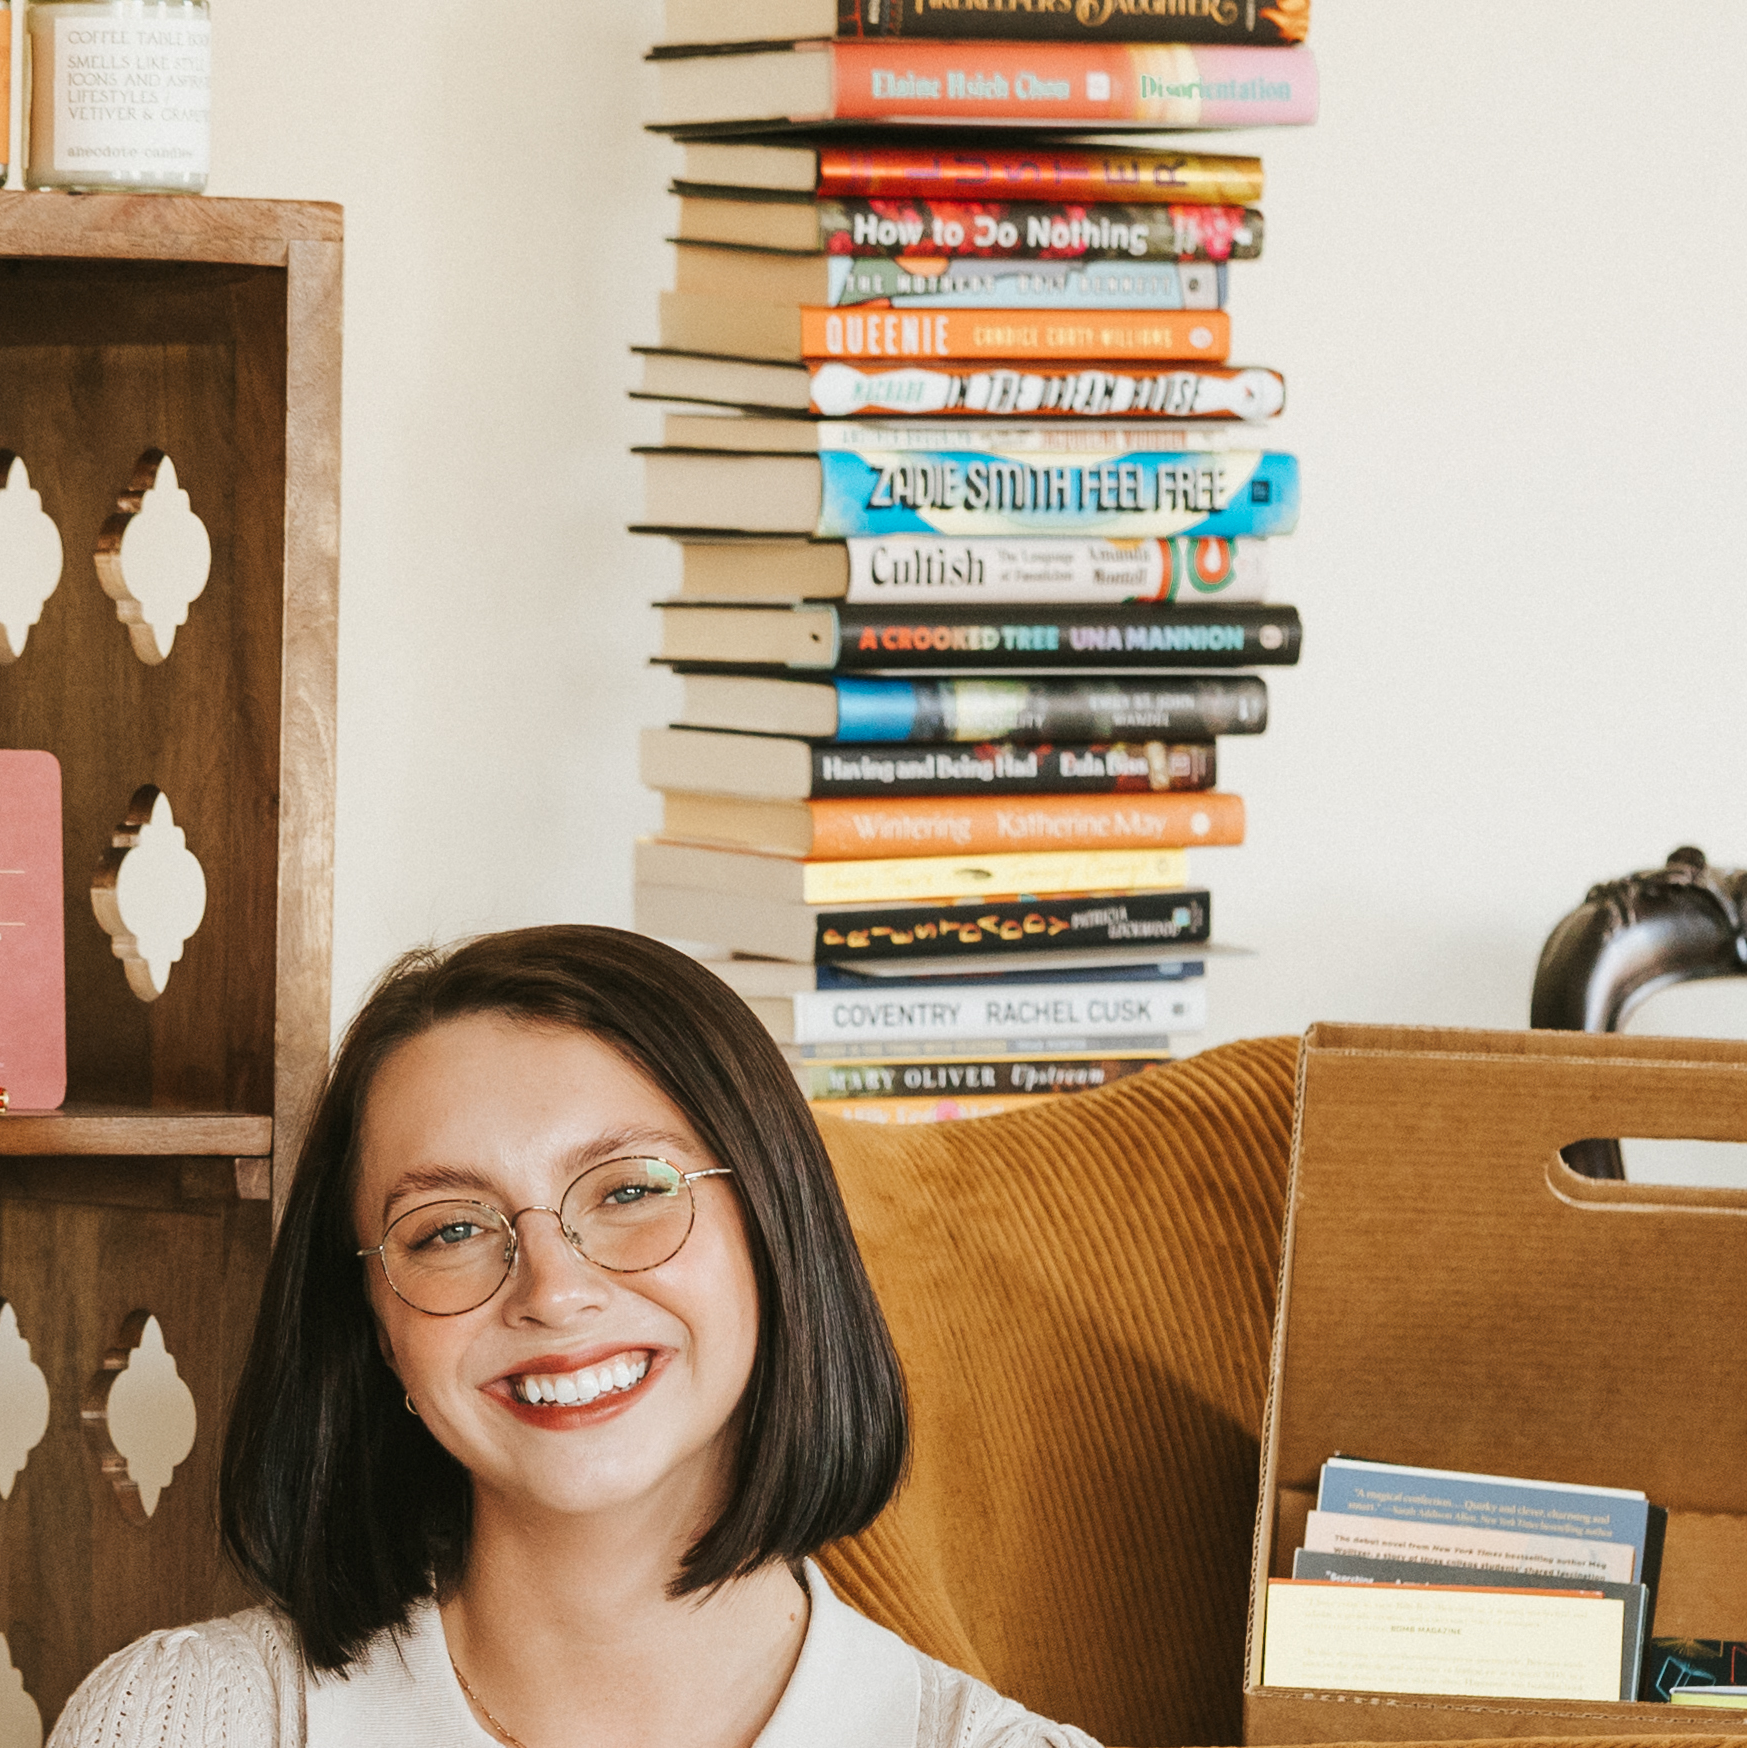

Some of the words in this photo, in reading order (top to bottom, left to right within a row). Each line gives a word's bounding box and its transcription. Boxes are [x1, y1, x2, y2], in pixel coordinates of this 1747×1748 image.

[853, 212, 925, 247] How
[932, 214, 965, 247] to
[1026, 216, 1150, 257] Nothing
[825, 315, 950, 356] QUEENIE
[868, 462, 959, 510] ZADIE
[965, 462, 1072, 510] SMITH
[1077, 463, 1146, 511] FEEL
[1156, 464, 1229, 511] FREE
[871, 545, 986, 587] Cultish
[858, 625, 879, 652] A
[881, 625, 1000, 652] CROOKED
[1002, 625, 1060, 652] TREE
[1070, 625, 1123, 651] UNA
[1125, 625, 1245, 652] MANNION
[822, 755, 896, 784] Having
[895, 754, 936, 780] and
[852, 812, 973, 844] Wintering
[995, 811, 1112, 840] Katherine
[1112, 810, 1168, 839] May
[832, 1002, 963, 1029] COVENTRY
[985, 1001, 1079, 1026] RACHEL
[1087, 999, 1152, 1024] CUSK
[903, 1064, 996, 1090] OLIVER
